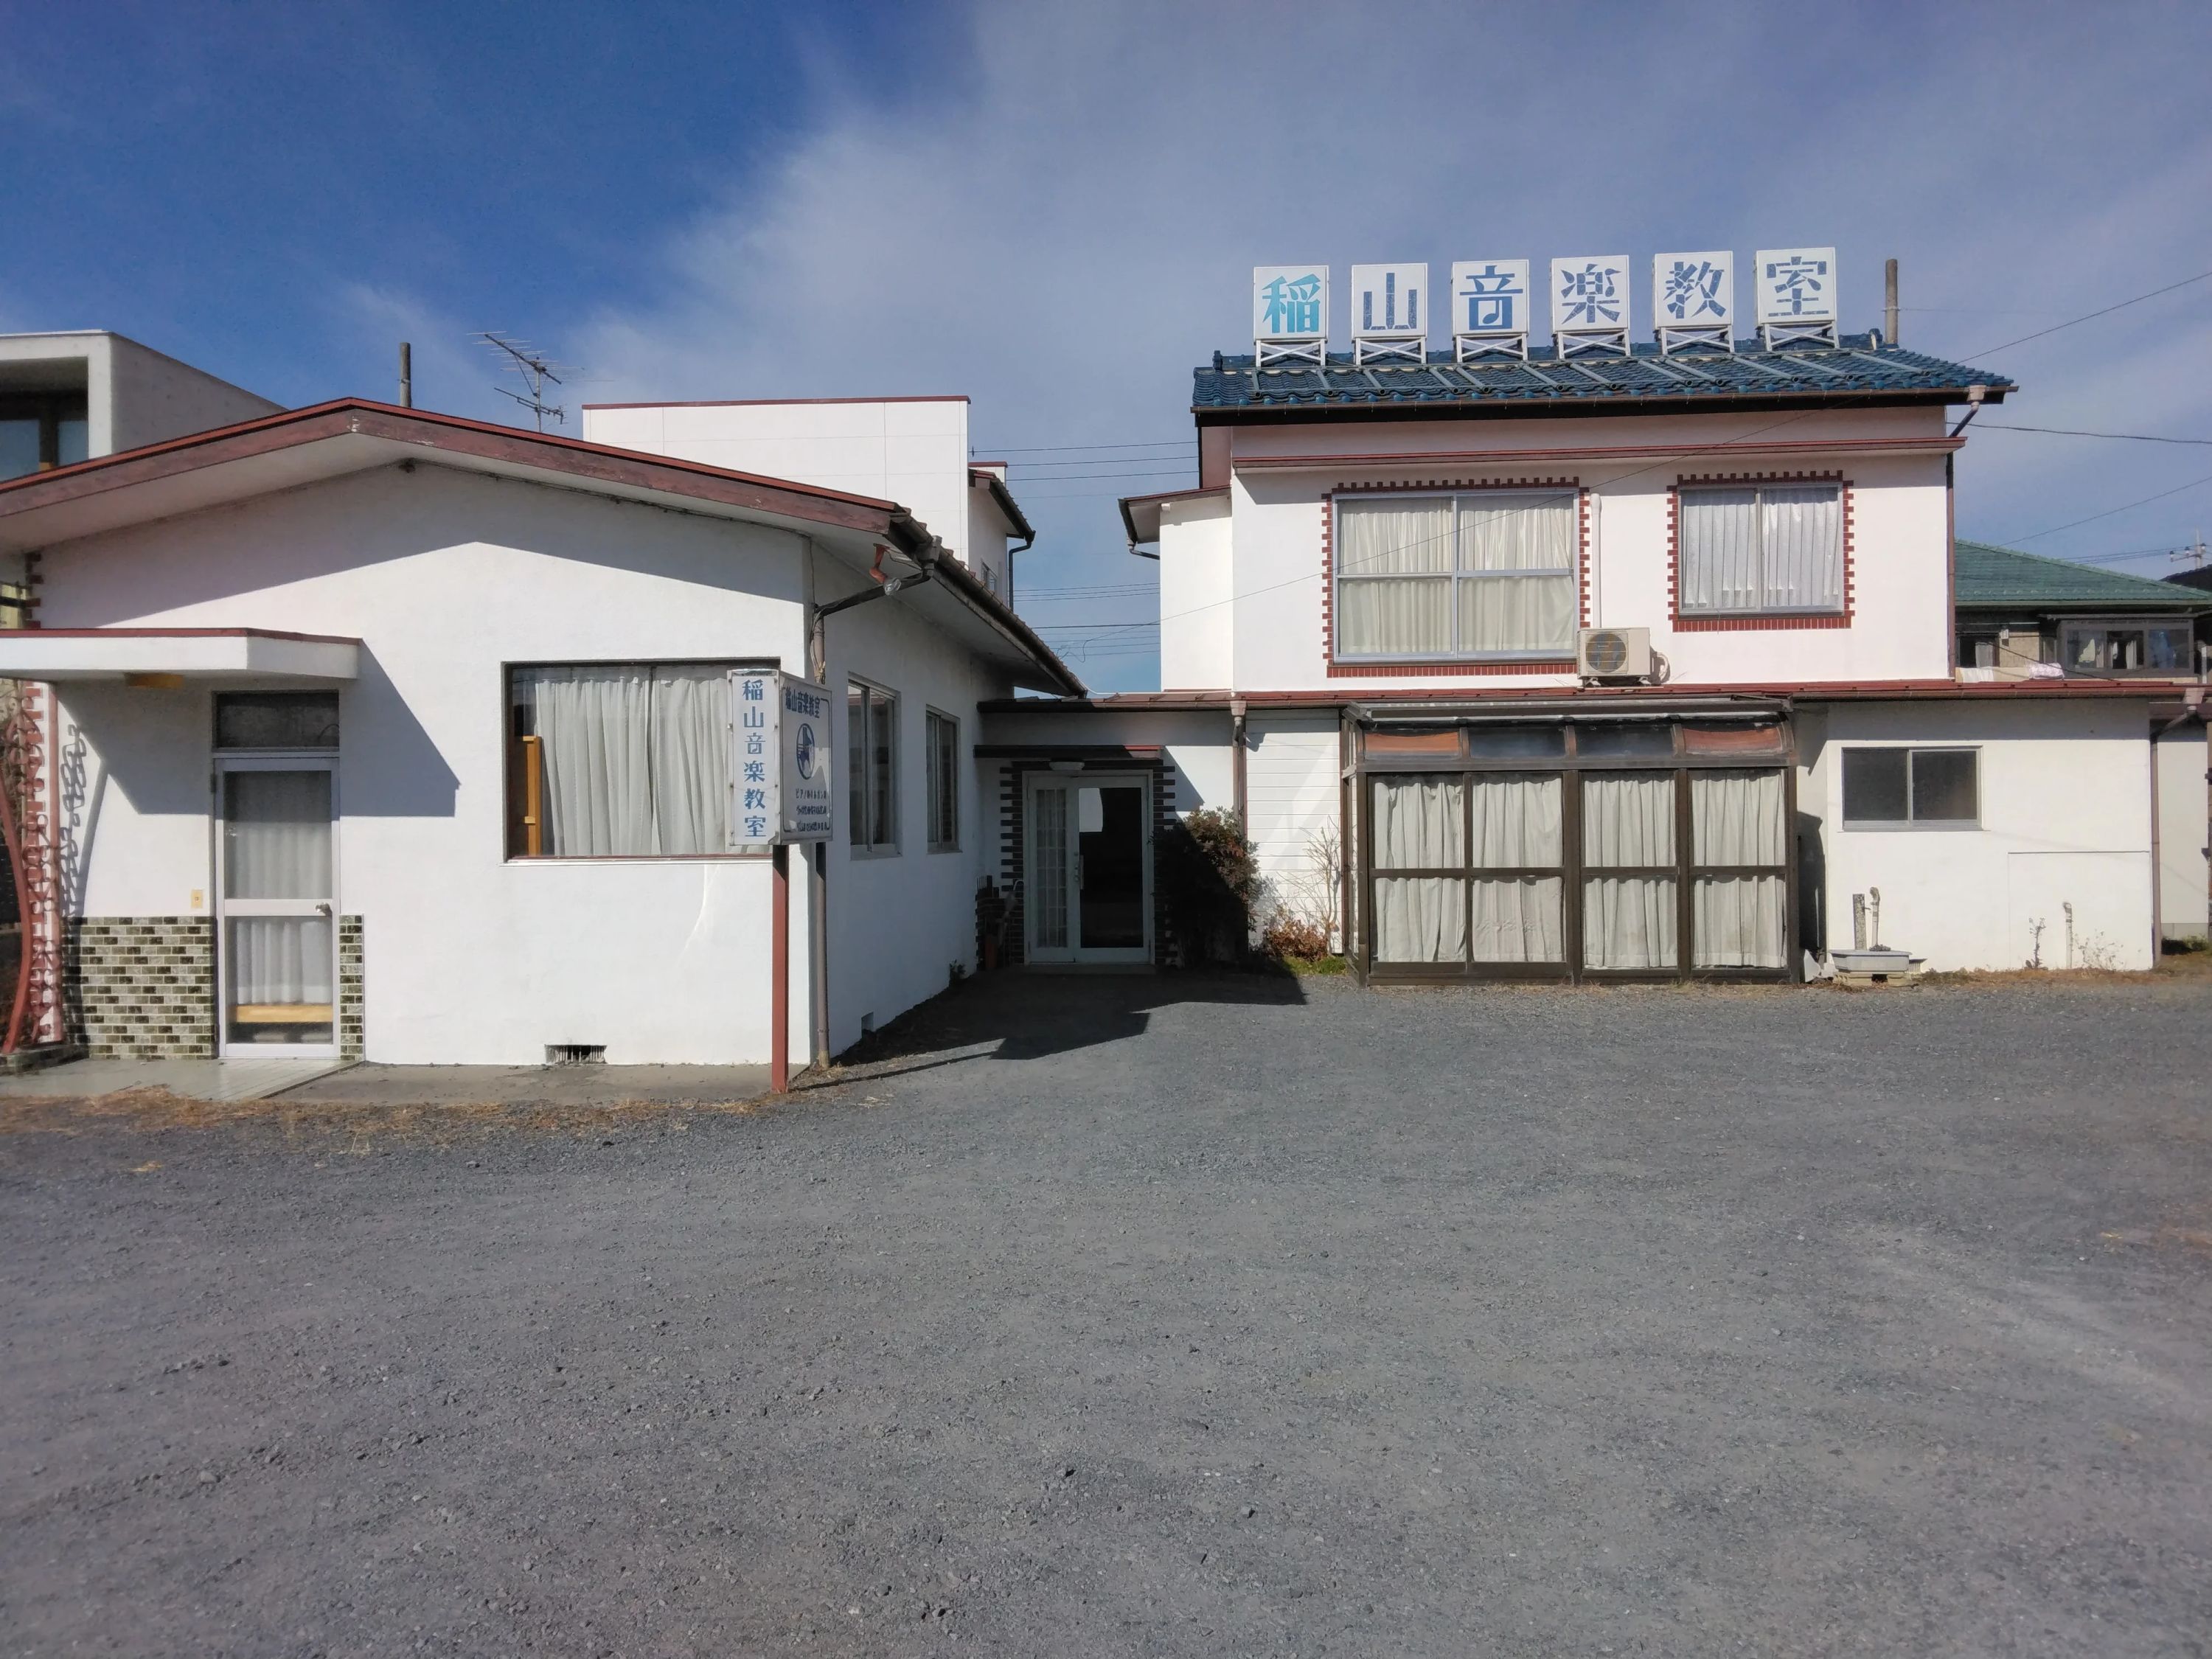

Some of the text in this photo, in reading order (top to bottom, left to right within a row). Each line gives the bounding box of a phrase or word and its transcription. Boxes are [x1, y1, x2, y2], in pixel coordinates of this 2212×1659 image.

[1262, 255, 1830, 334] 稲山音楽教室
[742, 679, 767, 838] 稲山音楽教室
